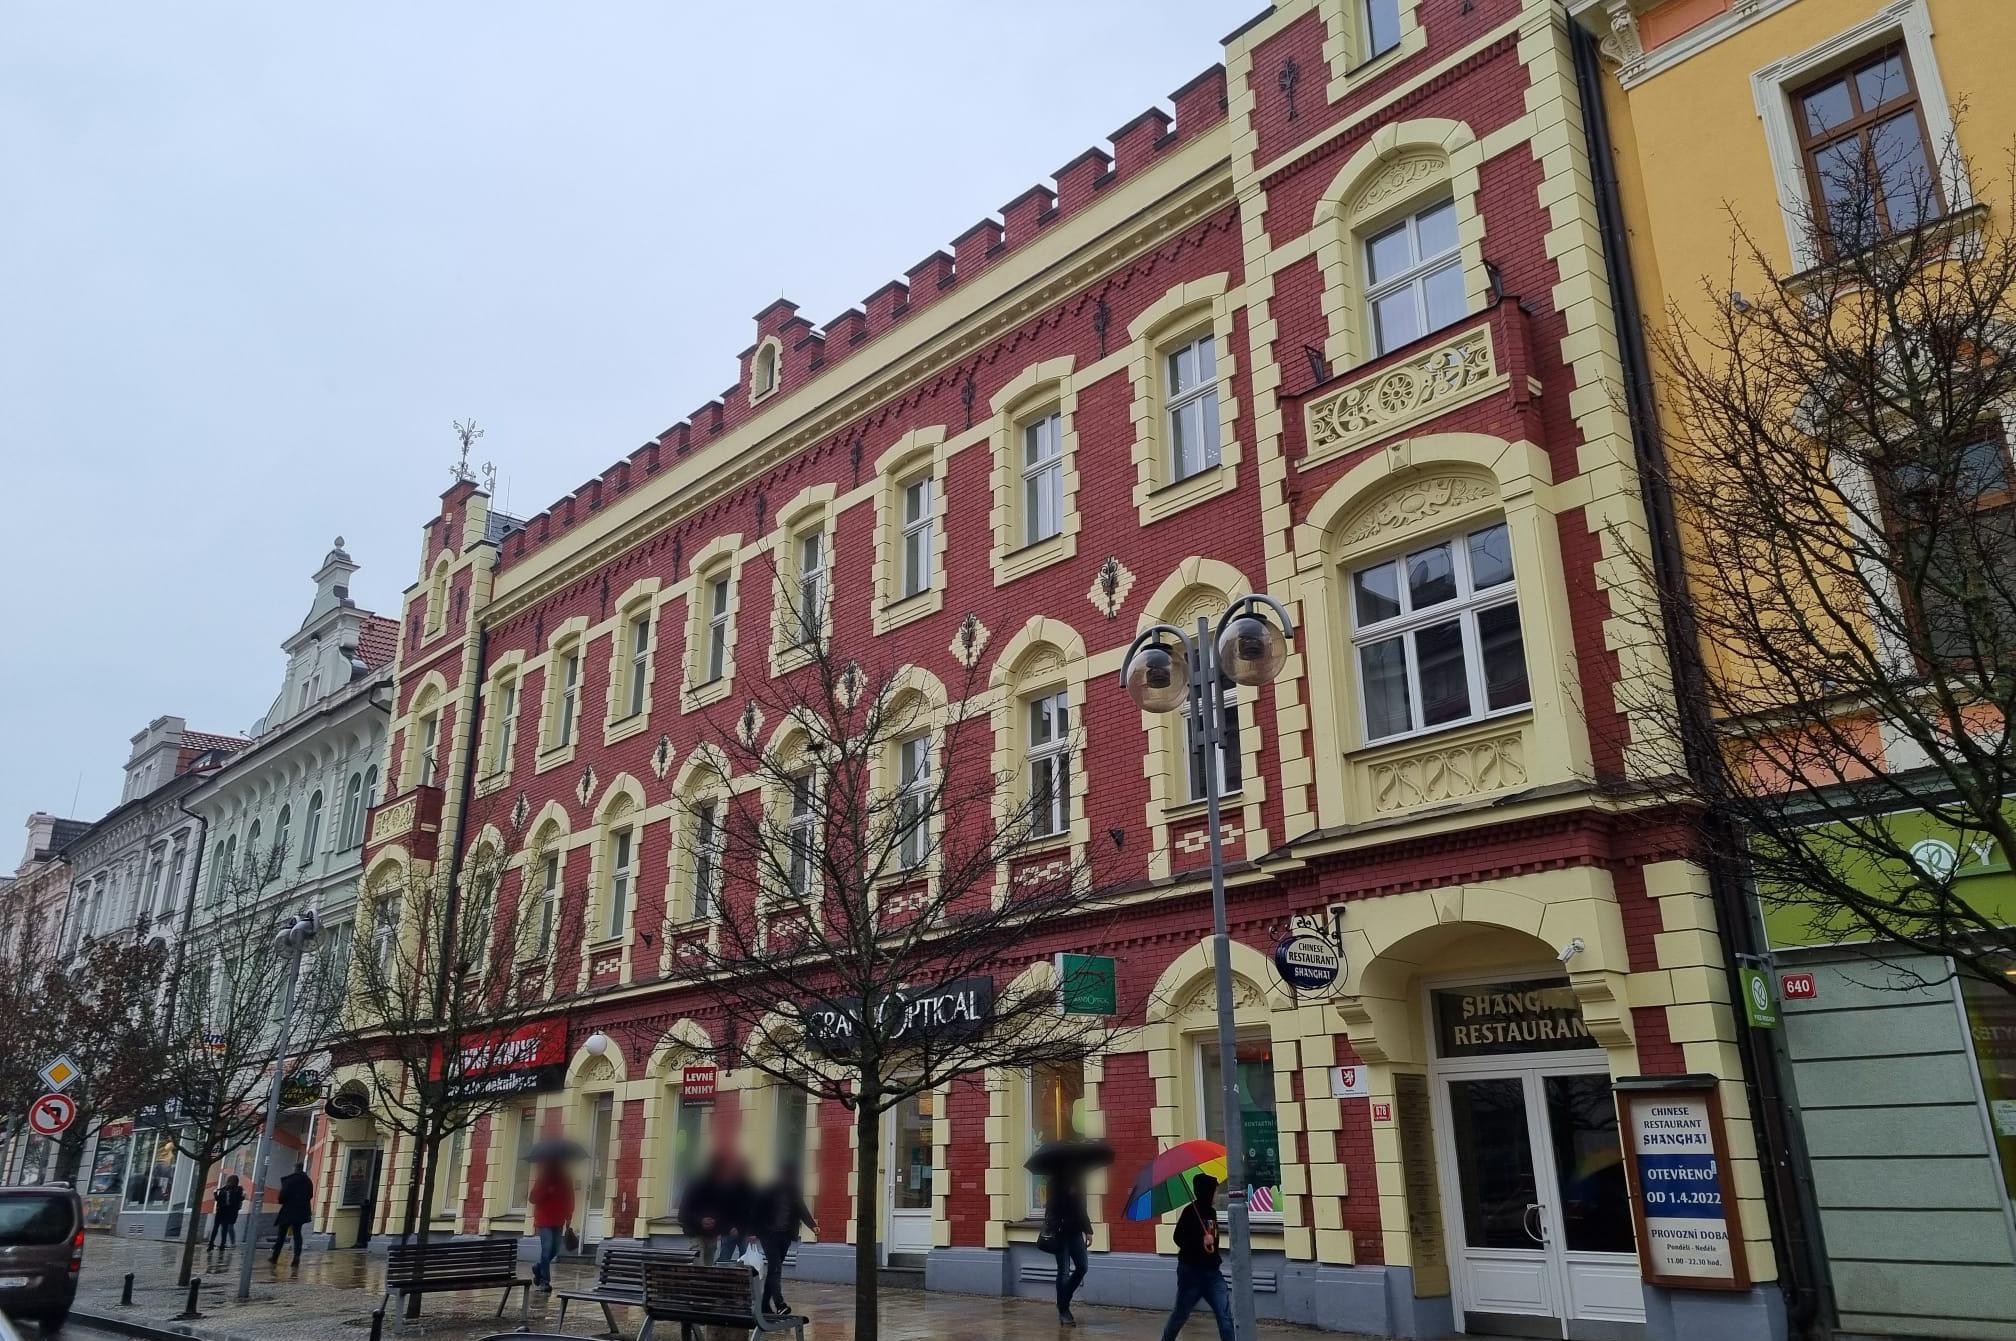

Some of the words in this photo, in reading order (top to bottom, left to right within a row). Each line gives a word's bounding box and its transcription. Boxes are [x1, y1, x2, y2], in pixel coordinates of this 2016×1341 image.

[1298, 942, 1324, 954] CHINESE
[1288, 951, 1335, 966] RESTAURANT
[1294, 967, 1331, 980] SHANGHAI
[1786, 980, 1810, 993] 640
[1454, 1017, 1590, 1046] RESTAURAN
[686, 1070, 714, 1082] LEVNÉ
[684, 1085, 714, 1095] KNIHY
[1651, 1107, 1690, 1117] CHINESE
[1643, 1119, 1702, 1129] RESTAURANT
[1643, 1133, 1707, 1146] SHANGHAI
[1647, 1164, 1714, 1180] OTEVŘENO
[1646, 1191, 1666, 1203] OD
[1669, 1192, 1722, 1205] 1.4.2022
[1651, 1228, 1698, 1239] PROVOZNÍ
[1700, 1231, 1729, 1240] DOBA
